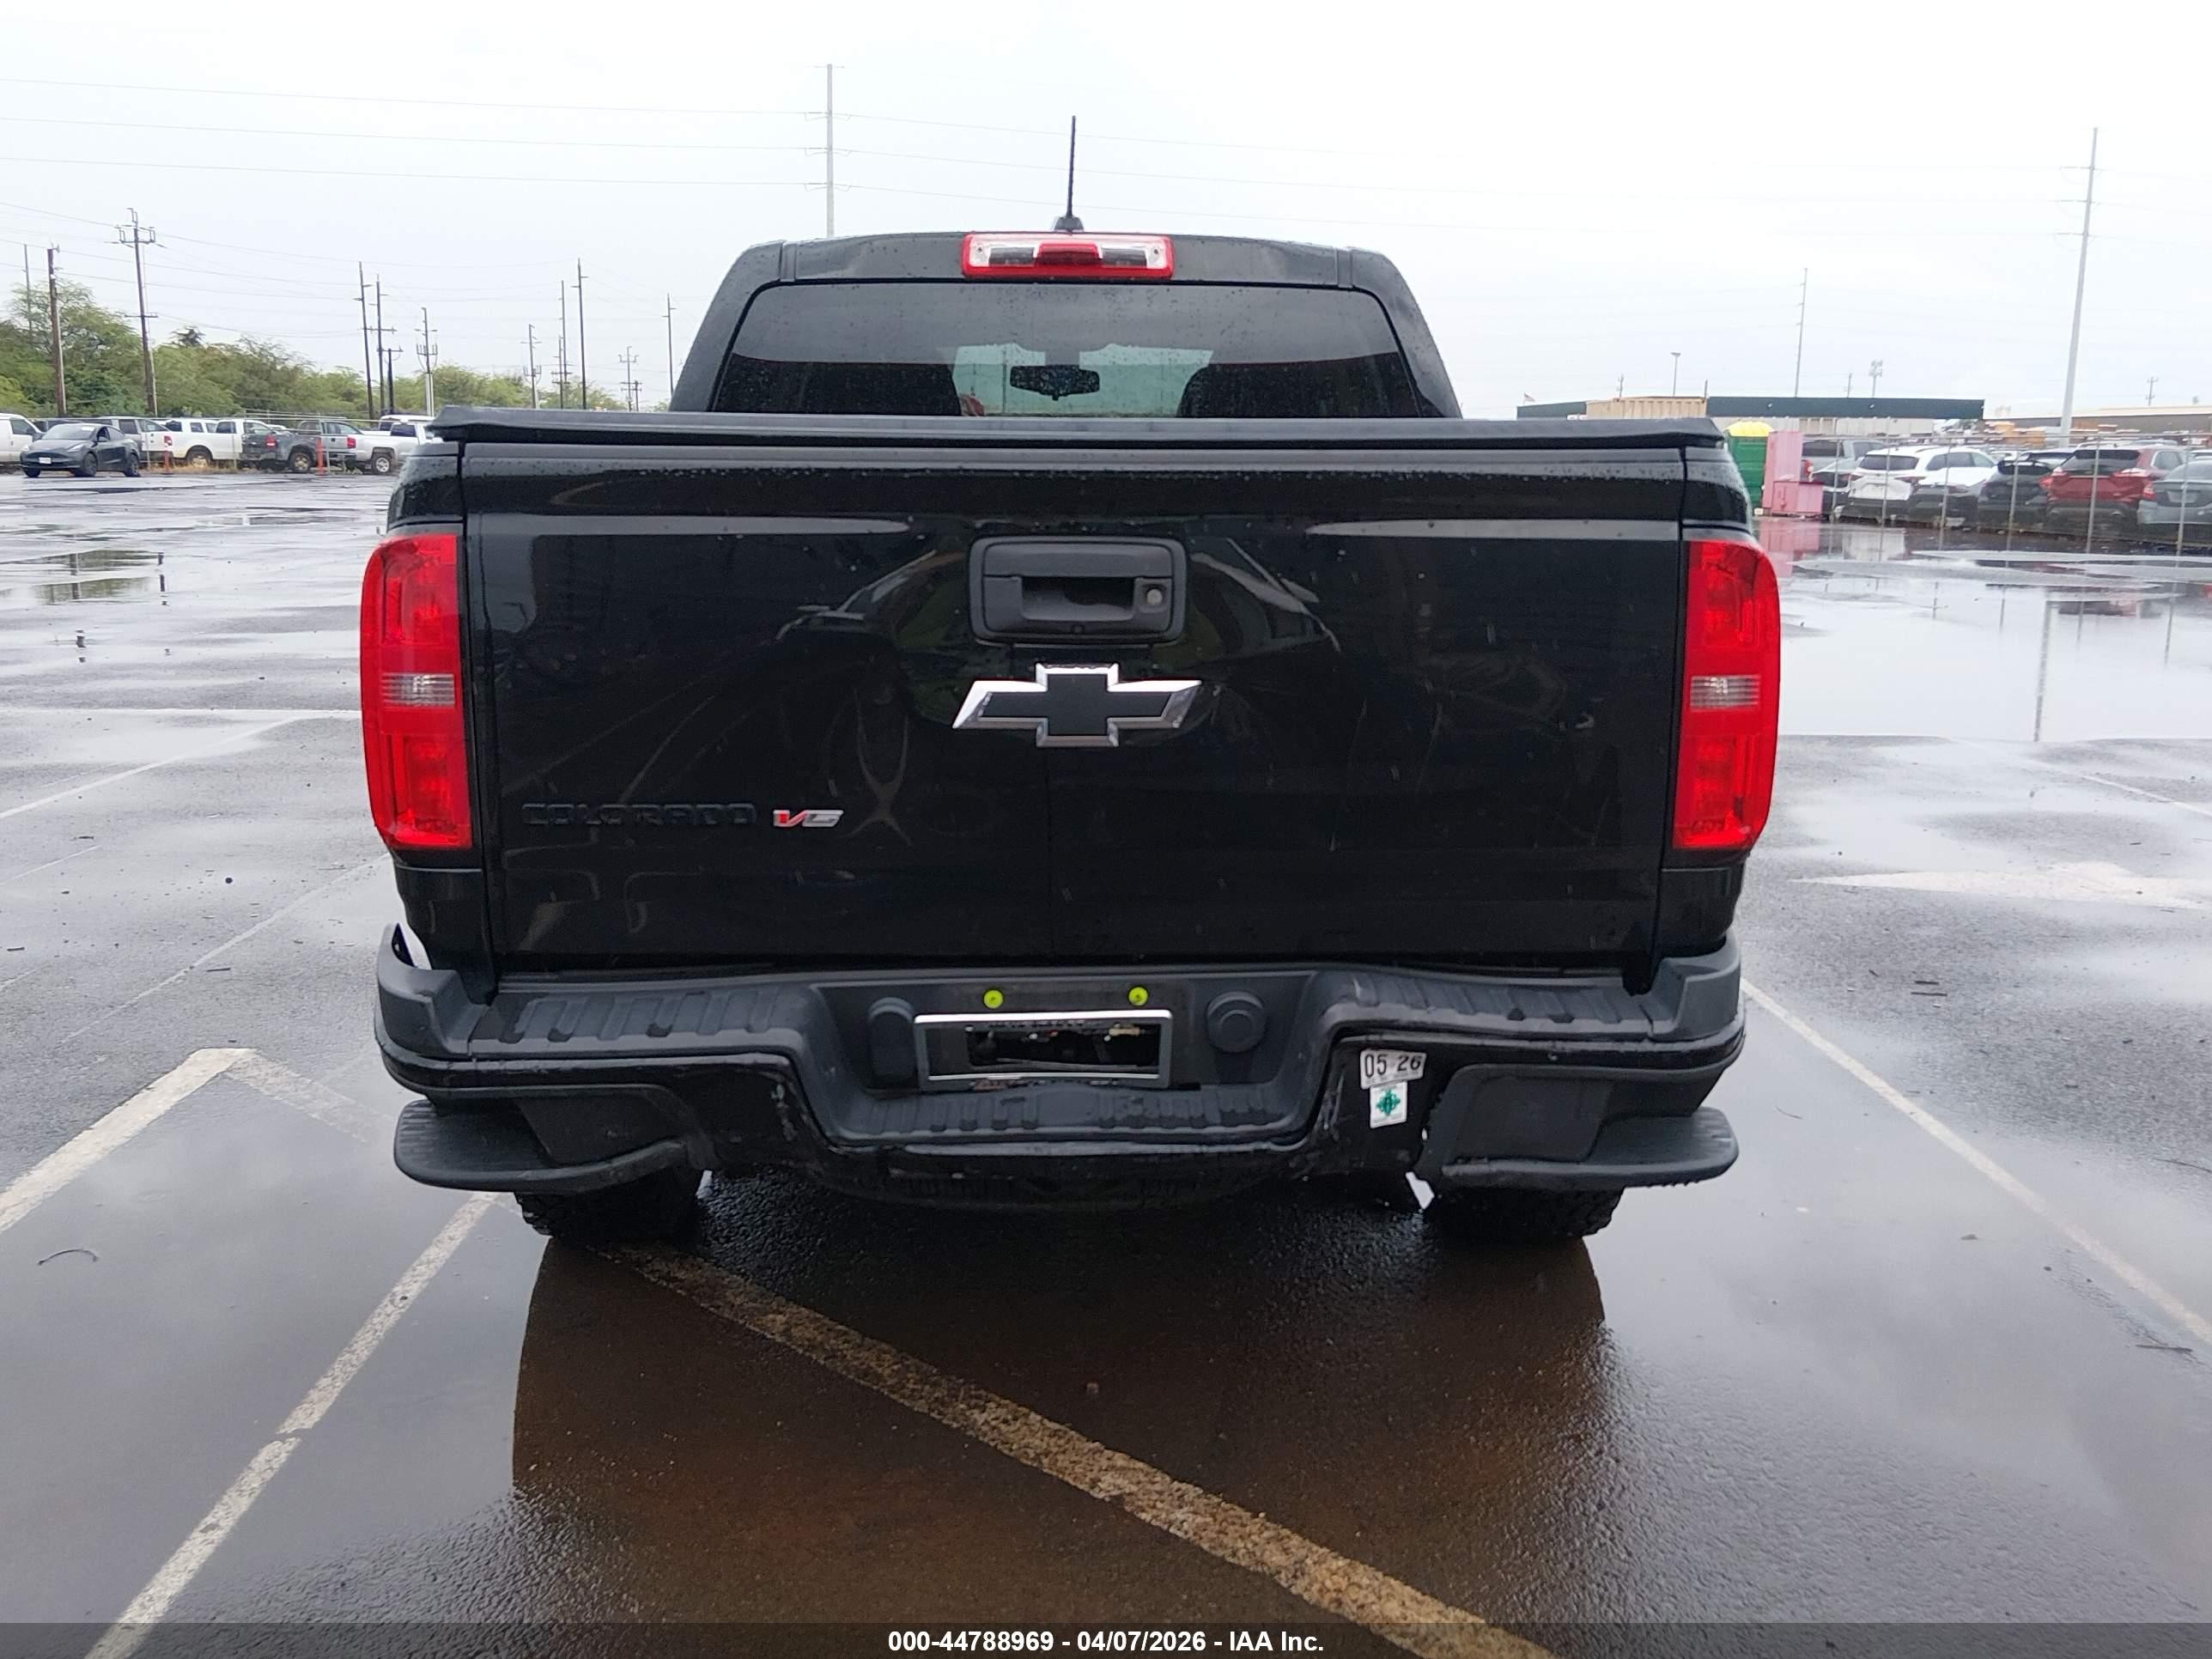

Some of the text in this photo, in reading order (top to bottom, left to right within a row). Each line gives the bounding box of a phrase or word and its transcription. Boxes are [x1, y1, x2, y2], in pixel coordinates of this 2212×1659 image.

[521, 802, 844, 828] COLORADO V6
[1364, 1054, 1388, 1078] 05
[1397, 1054, 1422, 1072] 26
